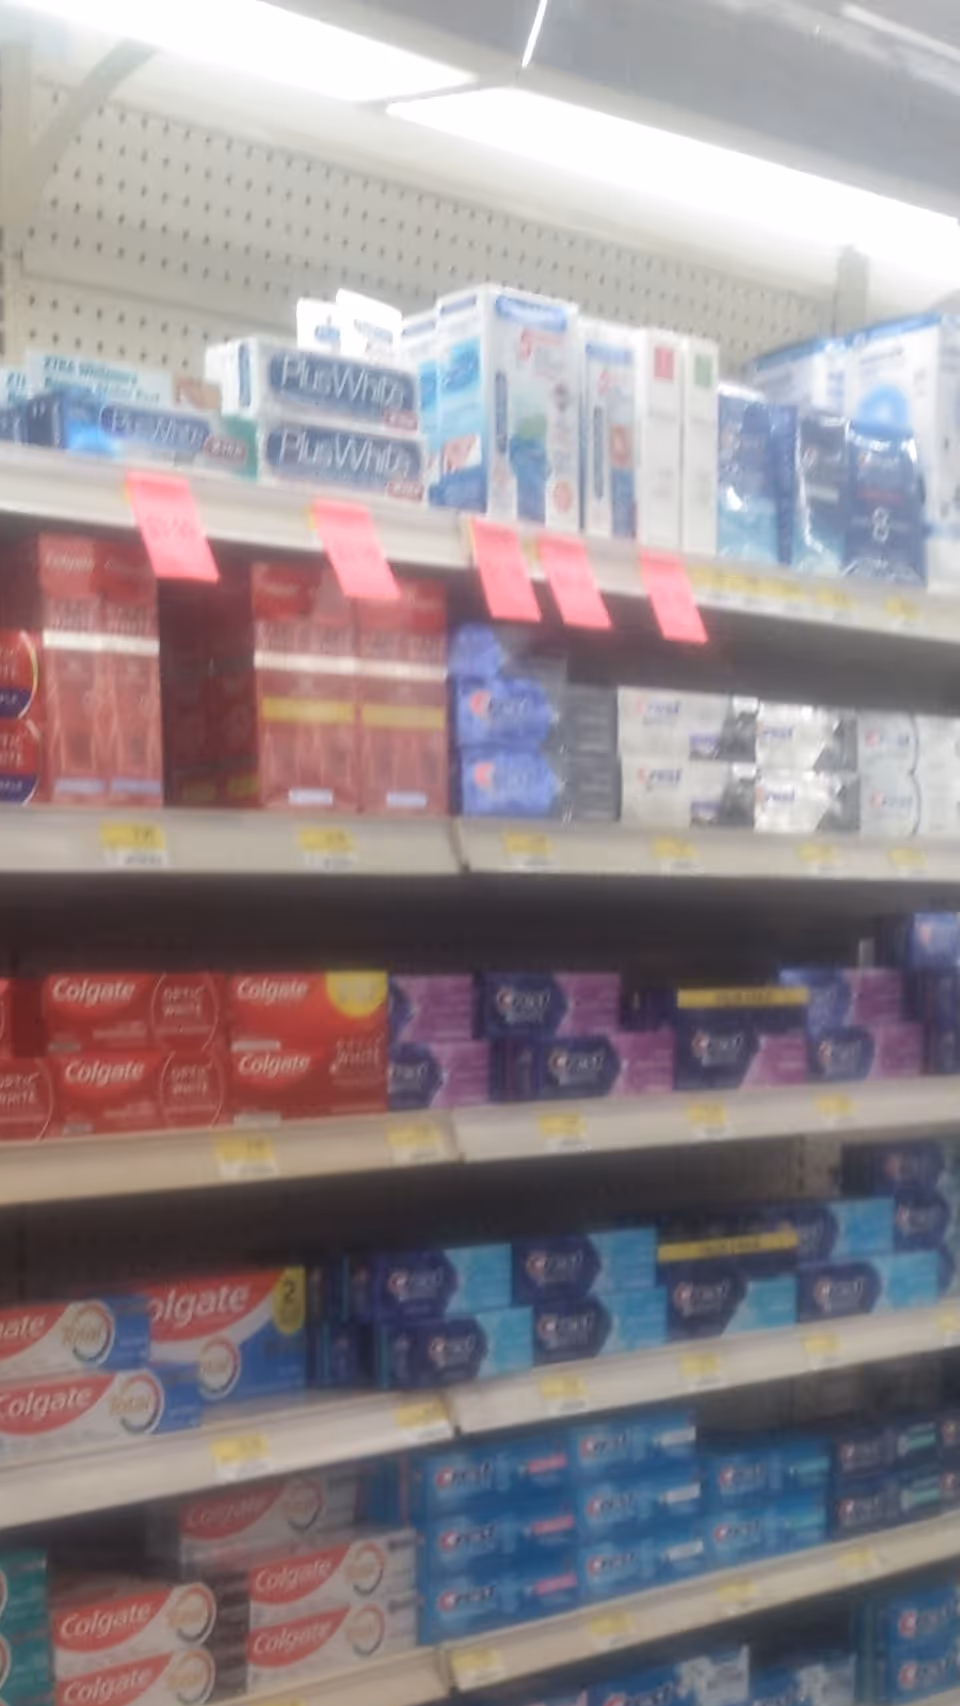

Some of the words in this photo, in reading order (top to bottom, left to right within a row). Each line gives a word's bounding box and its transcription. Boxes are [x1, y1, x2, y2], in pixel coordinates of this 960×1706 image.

[51, 978, 136, 1005] Colgate
[237, 979, 310, 1005] Colgate
[65, 1061, 146, 1087] Colgate
[238, 1053, 311, 1079] Colgate
[150, 1282, 252, 1325] olgate
[255, 1559, 333, 1594] Colgate
[59, 1602, 152, 1641] Colgate
[253, 1618, 333, 1655] Colgate
[63, 1665, 154, 1704] Colgate
